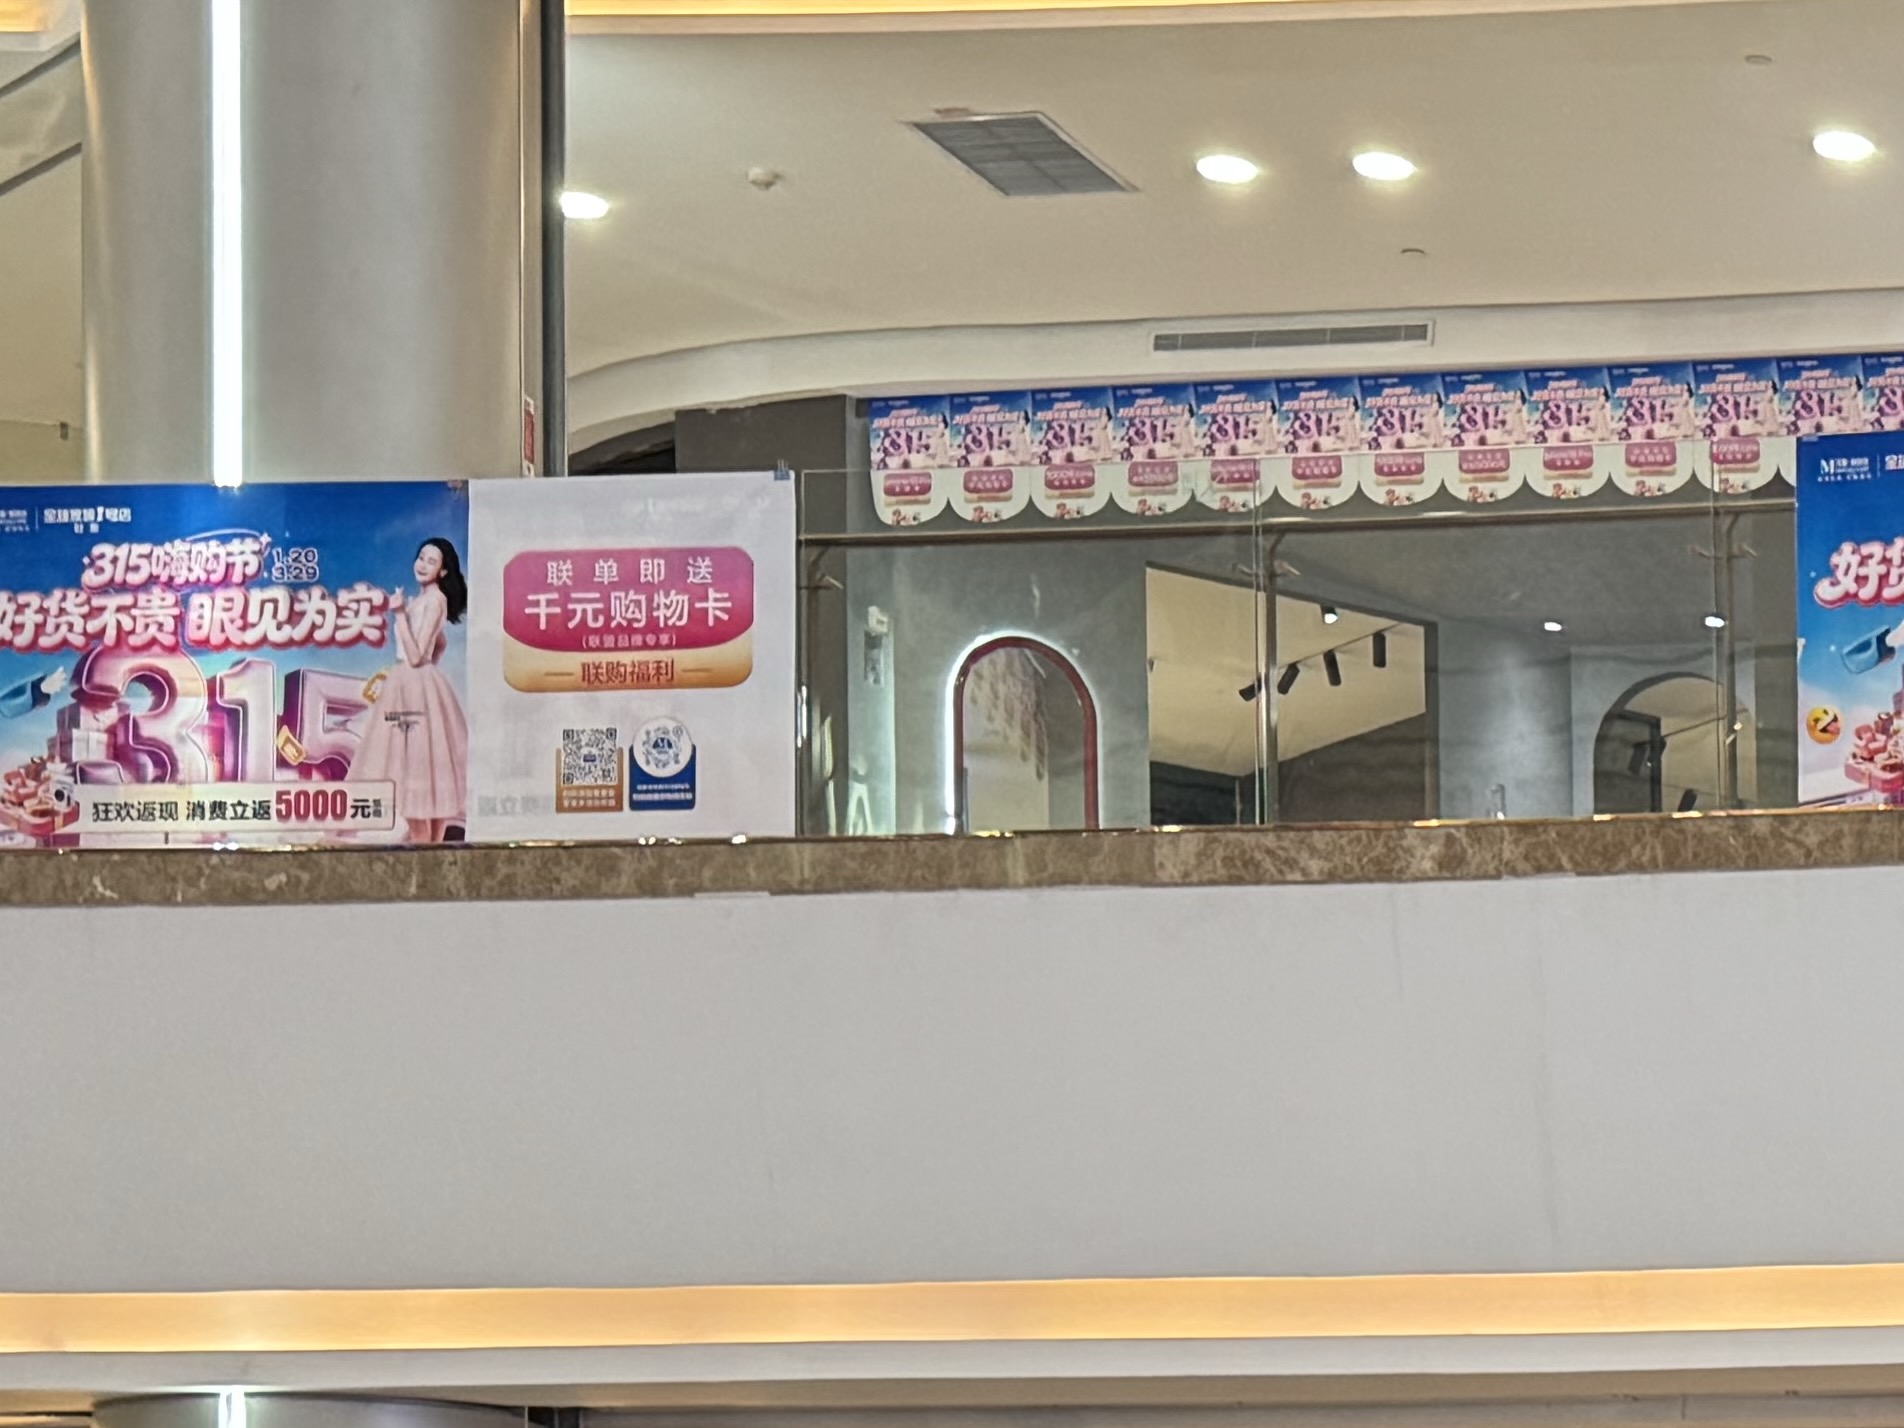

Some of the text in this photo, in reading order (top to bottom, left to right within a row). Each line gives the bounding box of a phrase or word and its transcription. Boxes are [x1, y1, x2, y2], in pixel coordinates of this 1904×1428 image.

[84, 538, 264, 589] 315嗨购节
[547, 557, 713, 586] 联单即送
[0, 585, 389, 650] 好货不贵 眼见为实
[525, 587, 732, 630] 千元购物卡
[580, 657, 675, 685] 联购福利
[92, 801, 179, 823] 狂欢返现
